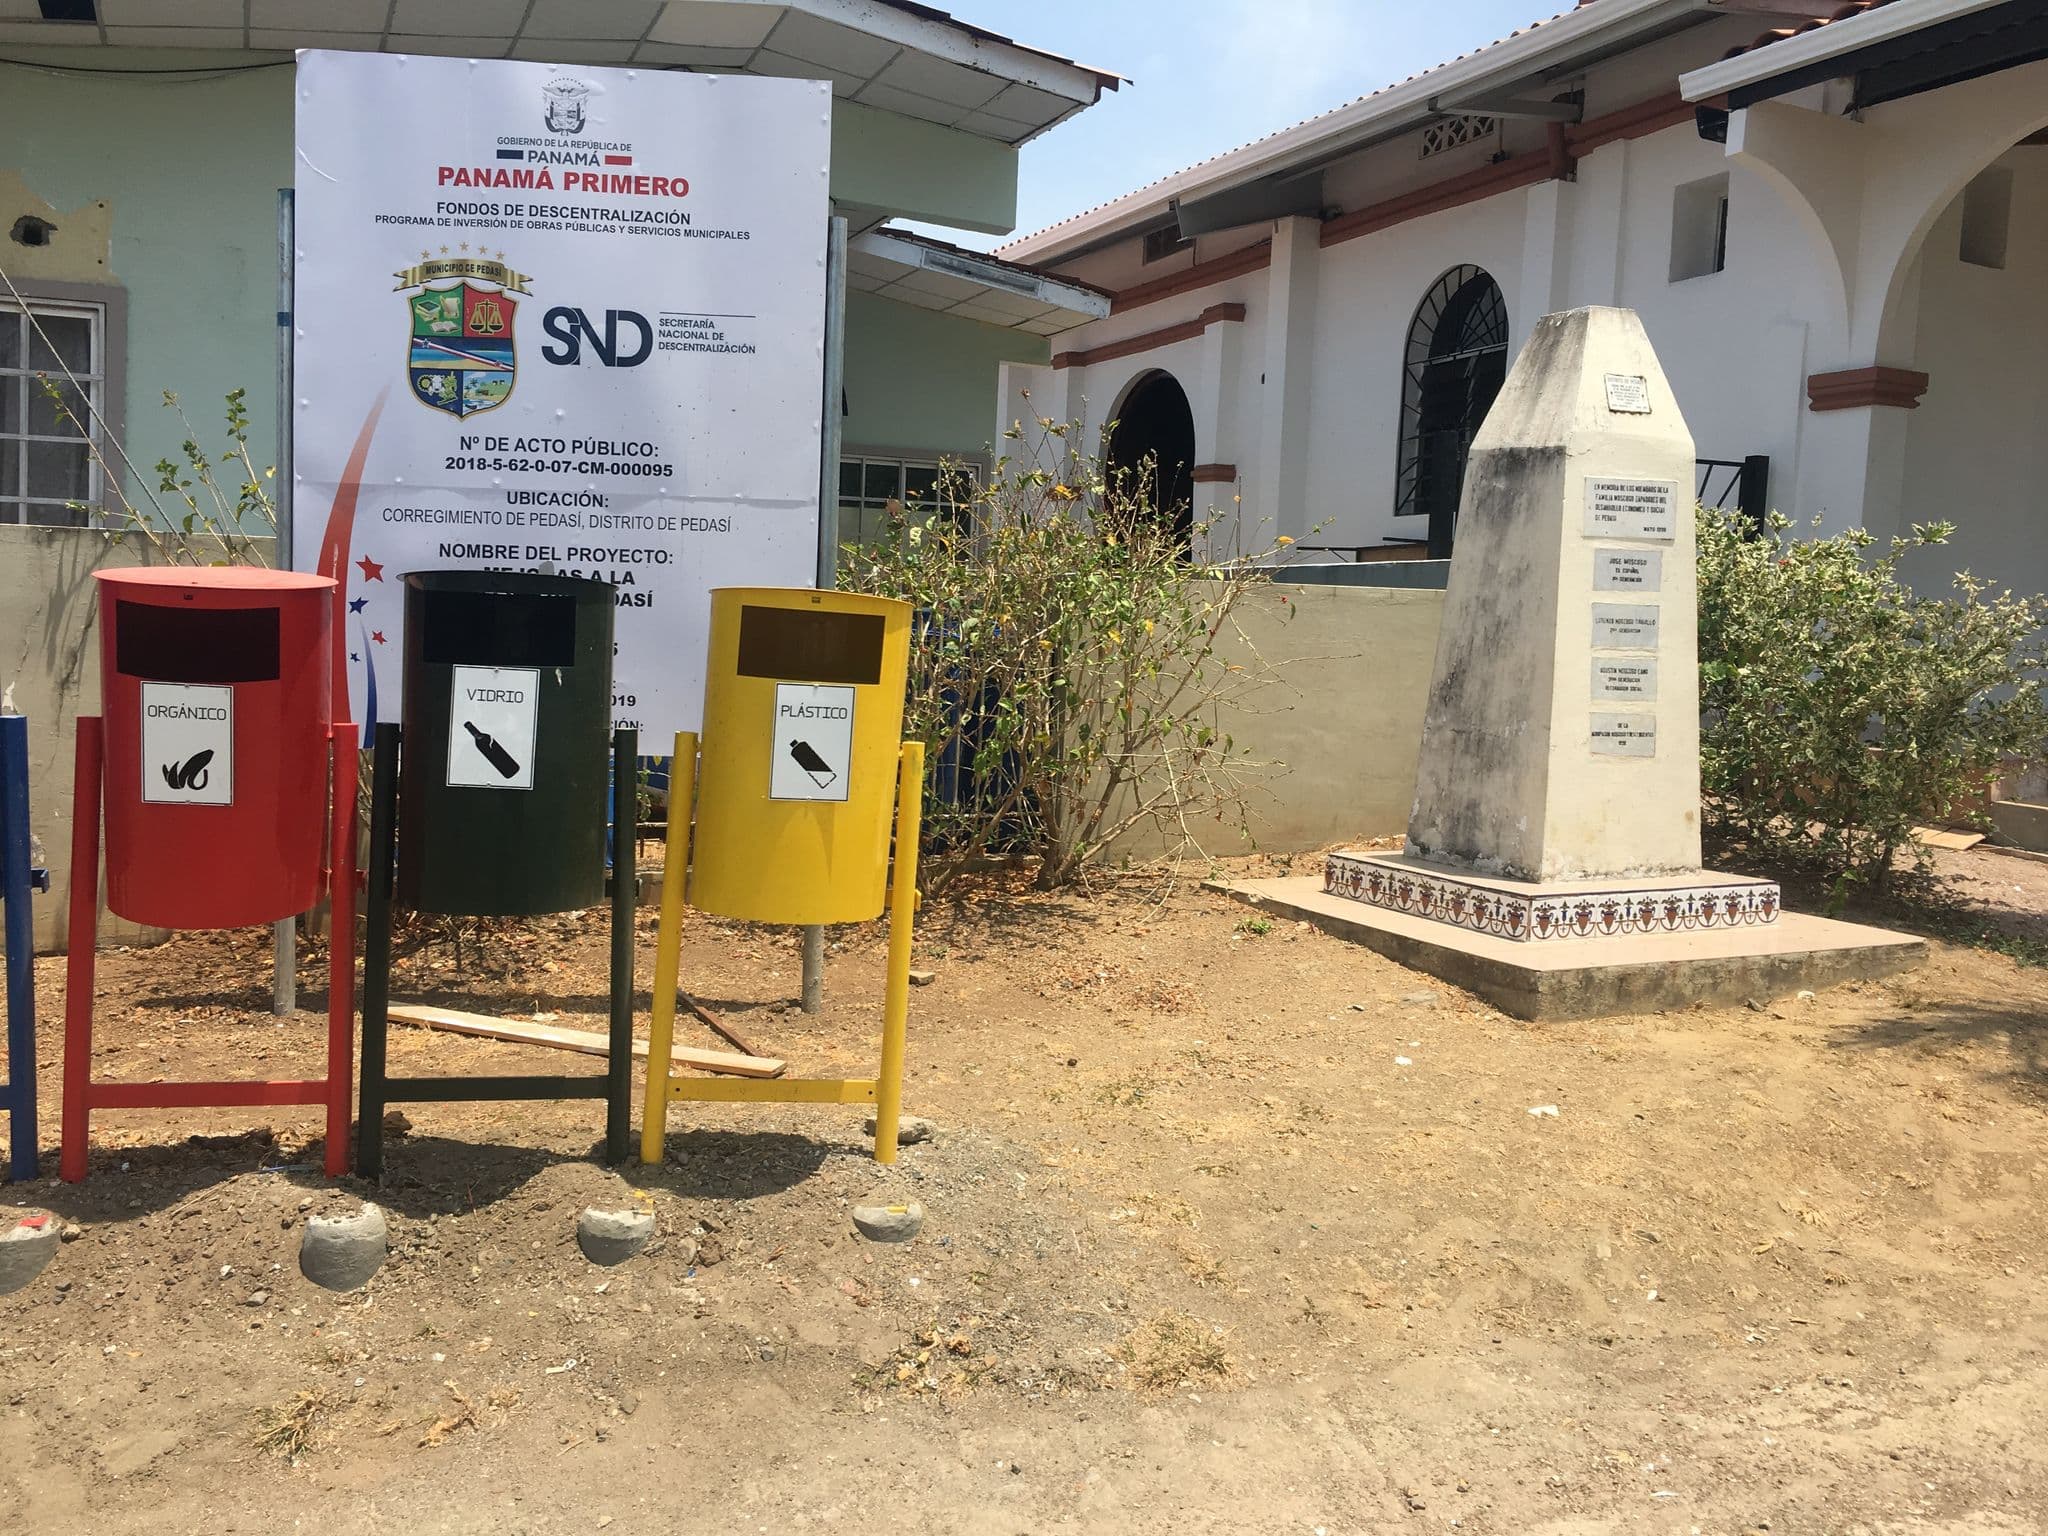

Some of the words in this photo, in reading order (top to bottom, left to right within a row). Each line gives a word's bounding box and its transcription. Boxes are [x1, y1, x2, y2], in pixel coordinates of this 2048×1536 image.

[497, 136, 542, 147] GOBIERNO
[544, 138, 556, 147] DE
[557, 139, 569, 148] LA
[570, 140, 618, 151] REPÚBLICA
[620, 143, 632, 152] DE
[528, 150, 600, 167] PANAMÁ
[438, 166, 554, 190] PANAMÁ
[563, 171, 690, 198] PRIMERO
[437, 201, 500, 216] FONDOS
[504, 203, 524, 217] DE
[529, 204, 691, 225] DESCENTRALIZACIÓN
[375, 214, 435, 226] PROGRAMA
[437, 217, 451, 227] DE
[453, 217, 508, 229] INVERSIÓN
[510, 219, 524, 230] DE
[526, 220, 563, 231] OBRAS
[565, 221, 616, 234] PÚBLICAS
[618, 225, 626, 234] Y
[627, 225, 681, 238] SERVICIOS
[683, 228, 751, 241] MUNICIPALES
[425, 263, 464, 275] MUNICIPIO
[659, 318, 715, 329] SECRETARÍA
[541, 306, 654, 368] SND
[658, 329, 710, 341] NACIONAL
[712, 331, 724, 341] DE
[658, 341, 756, 354] DESCENTRALIZACIÓN
[485, 436, 510, 452] DE
[514, 437, 566, 454] ACTO
[572, 436, 659, 457] PÚBLICO:
[445, 456, 673, 477] 2018-5-62-0-07-CM-000095
[507, 490, 609, 508] UBICACIÓN:
[382, 508, 502, 525] CORREGIMIENTO
[506, 511, 525, 526] DE
[529, 511, 585, 529] PEDASÍ,
[589, 514, 654, 530] DISTRITO
[657, 517, 677, 531] DE
[681, 516, 732, 533] PEDASÍ
[439, 543, 520, 560] NOMBRE
[525, 545, 562, 561] DEL
[567, 547, 674, 565] PROYECTO:
[610, 570, 635, 585] LA
[467, 688, 525, 704] VIDRIO
[147, 703, 227, 721] ORGÁNICO
[780, 702, 848, 720] PLÁSTICO
